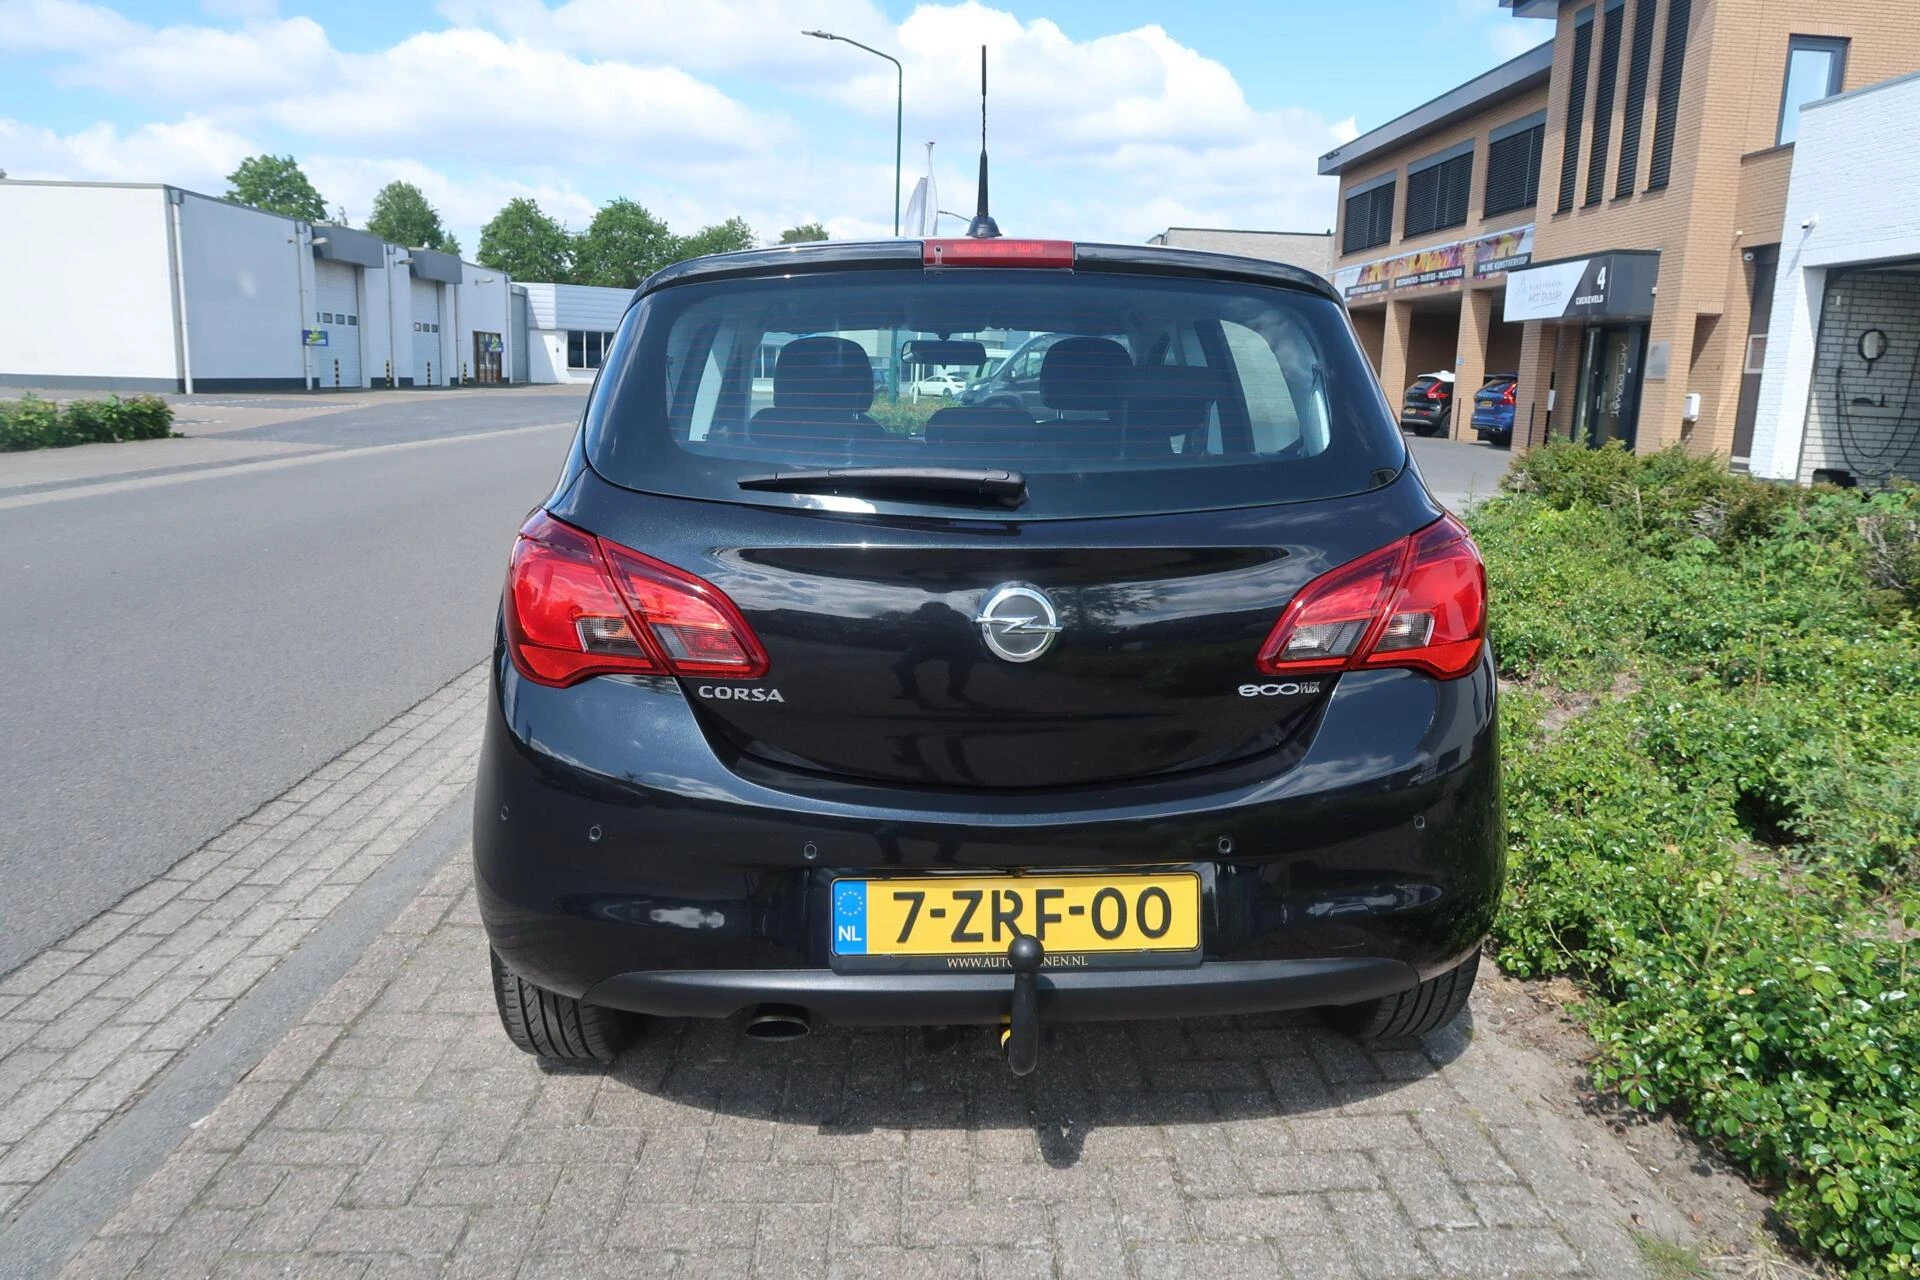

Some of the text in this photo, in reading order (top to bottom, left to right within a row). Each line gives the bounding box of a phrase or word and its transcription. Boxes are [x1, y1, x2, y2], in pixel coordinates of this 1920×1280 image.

[1597, 266, 1606, 290] 4
[698, 685, 785, 702] CORSA
[892, 886, 1172, 944] 7-ZRF-00
[838, 925, 862, 942] NL
